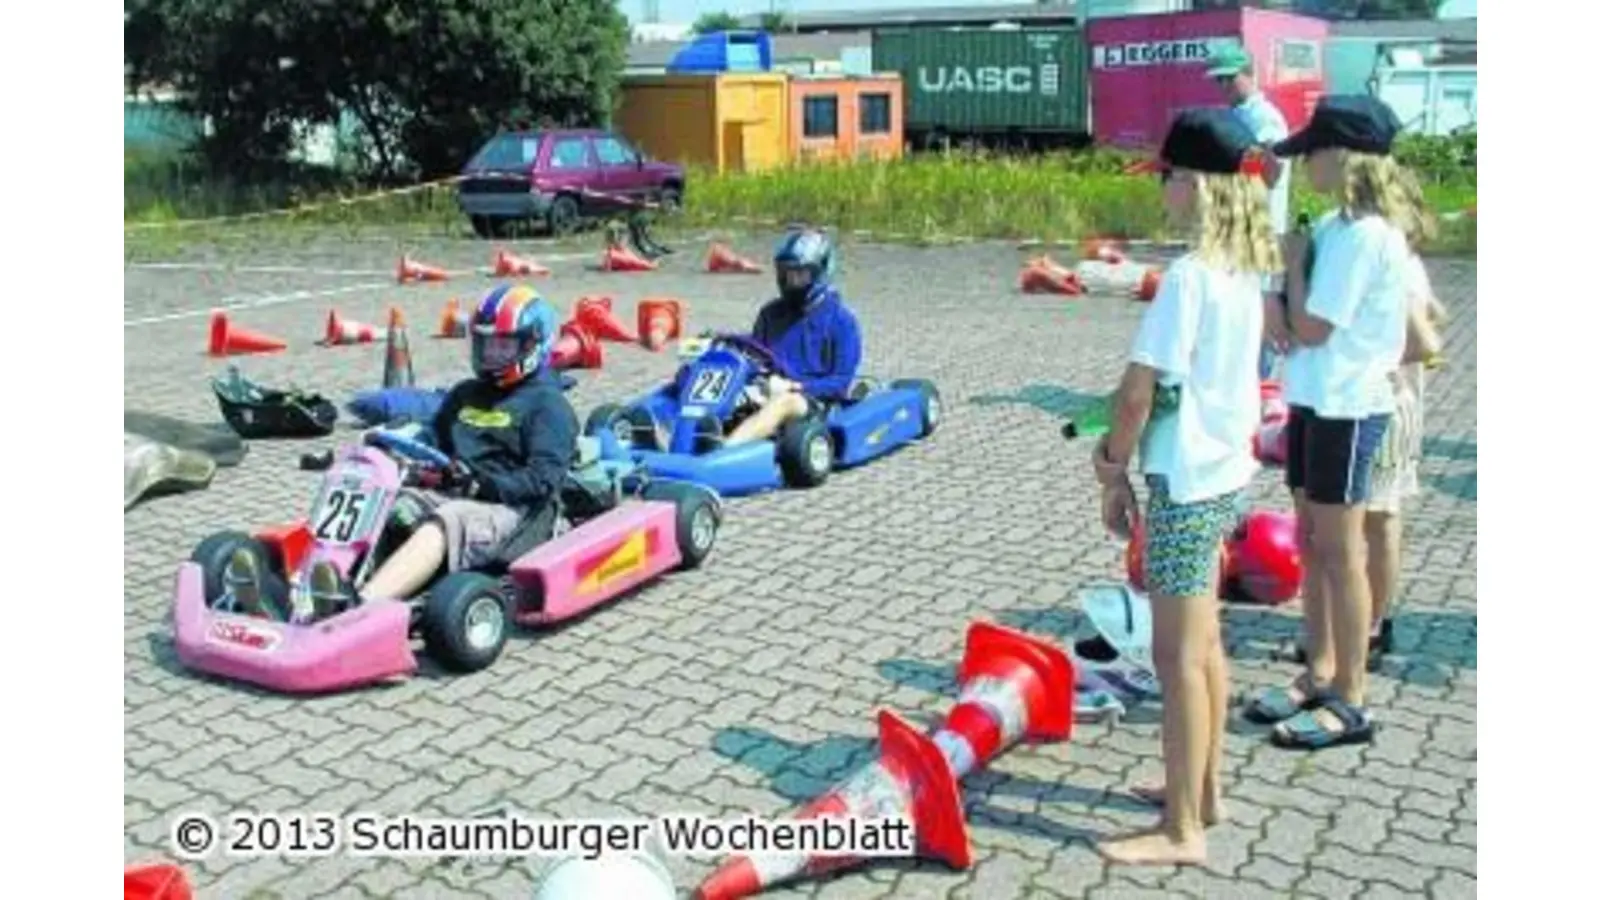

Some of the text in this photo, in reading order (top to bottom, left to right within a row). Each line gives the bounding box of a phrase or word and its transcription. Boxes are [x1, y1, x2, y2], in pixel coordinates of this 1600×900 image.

[917, 66, 1032, 93] UASC
[692, 371, 727, 400] 24
[316, 489, 365, 542] 25
